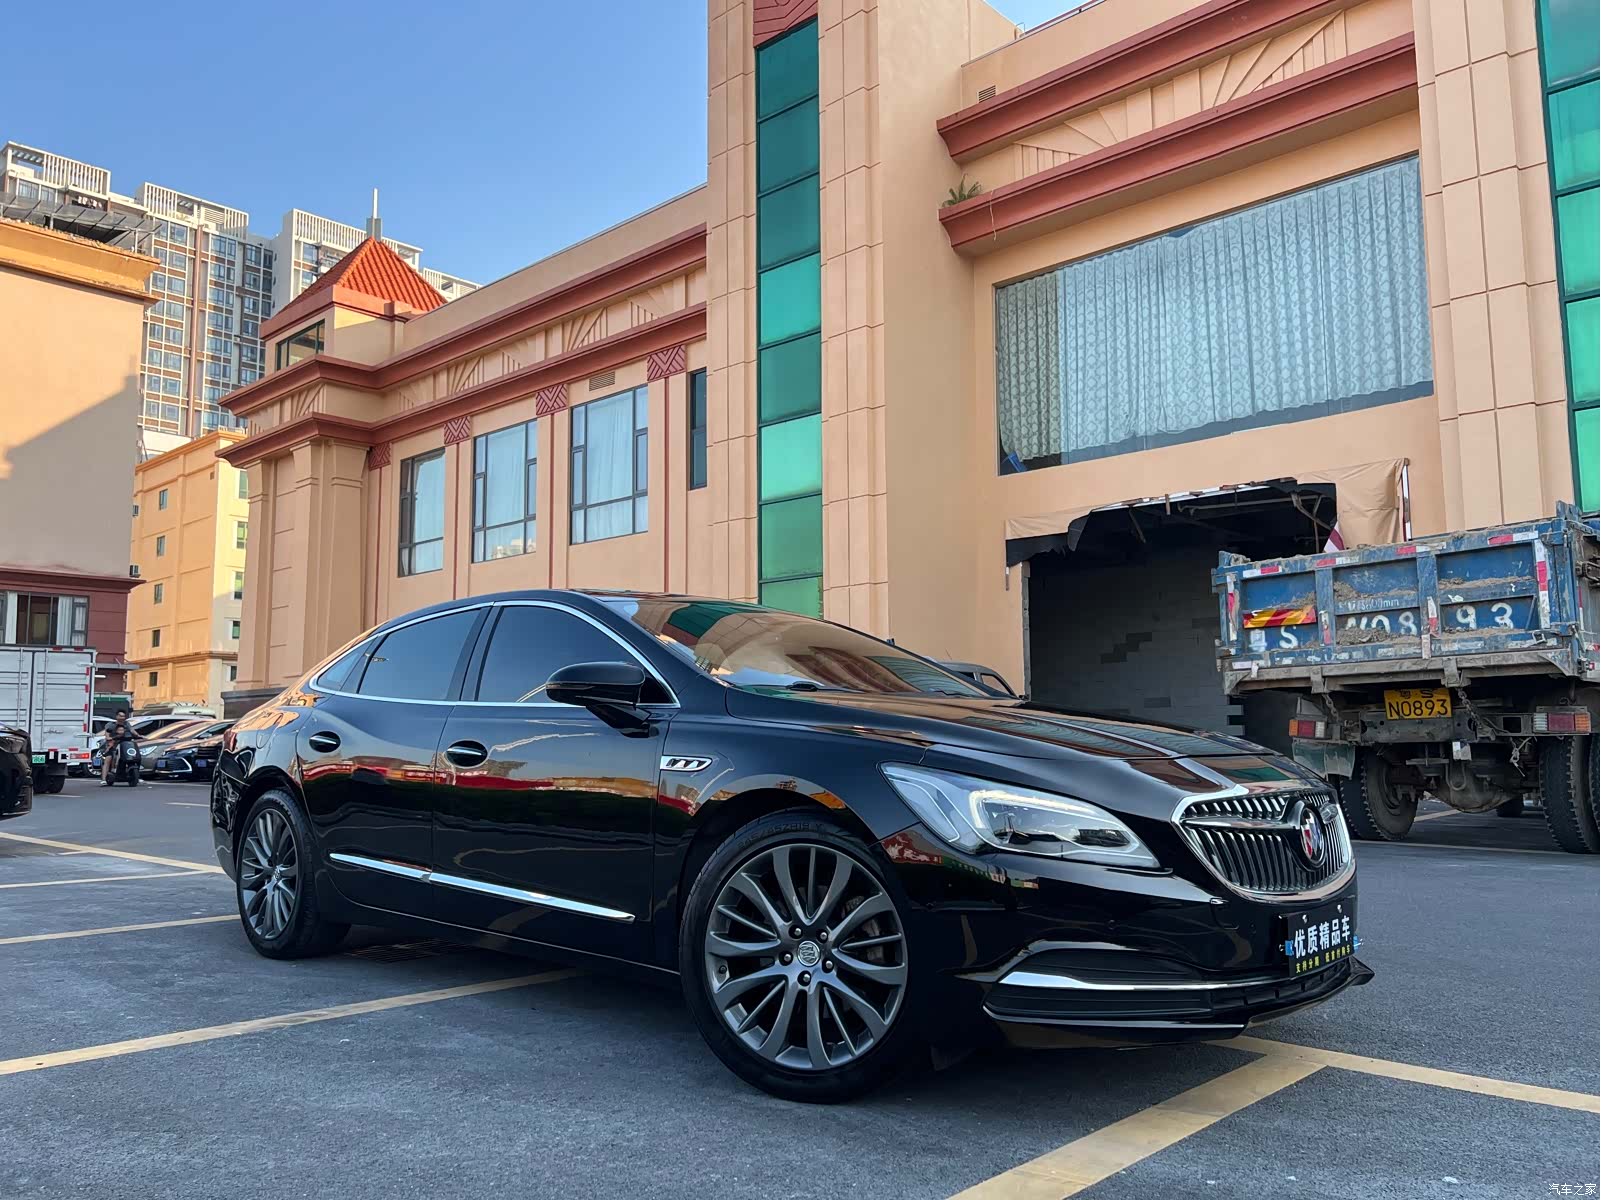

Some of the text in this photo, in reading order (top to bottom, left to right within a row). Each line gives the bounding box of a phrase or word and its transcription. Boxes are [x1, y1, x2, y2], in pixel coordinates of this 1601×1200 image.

[1388, 699, 1448, 717] N0893
[1294, 915, 1351, 959] 优质精品车
